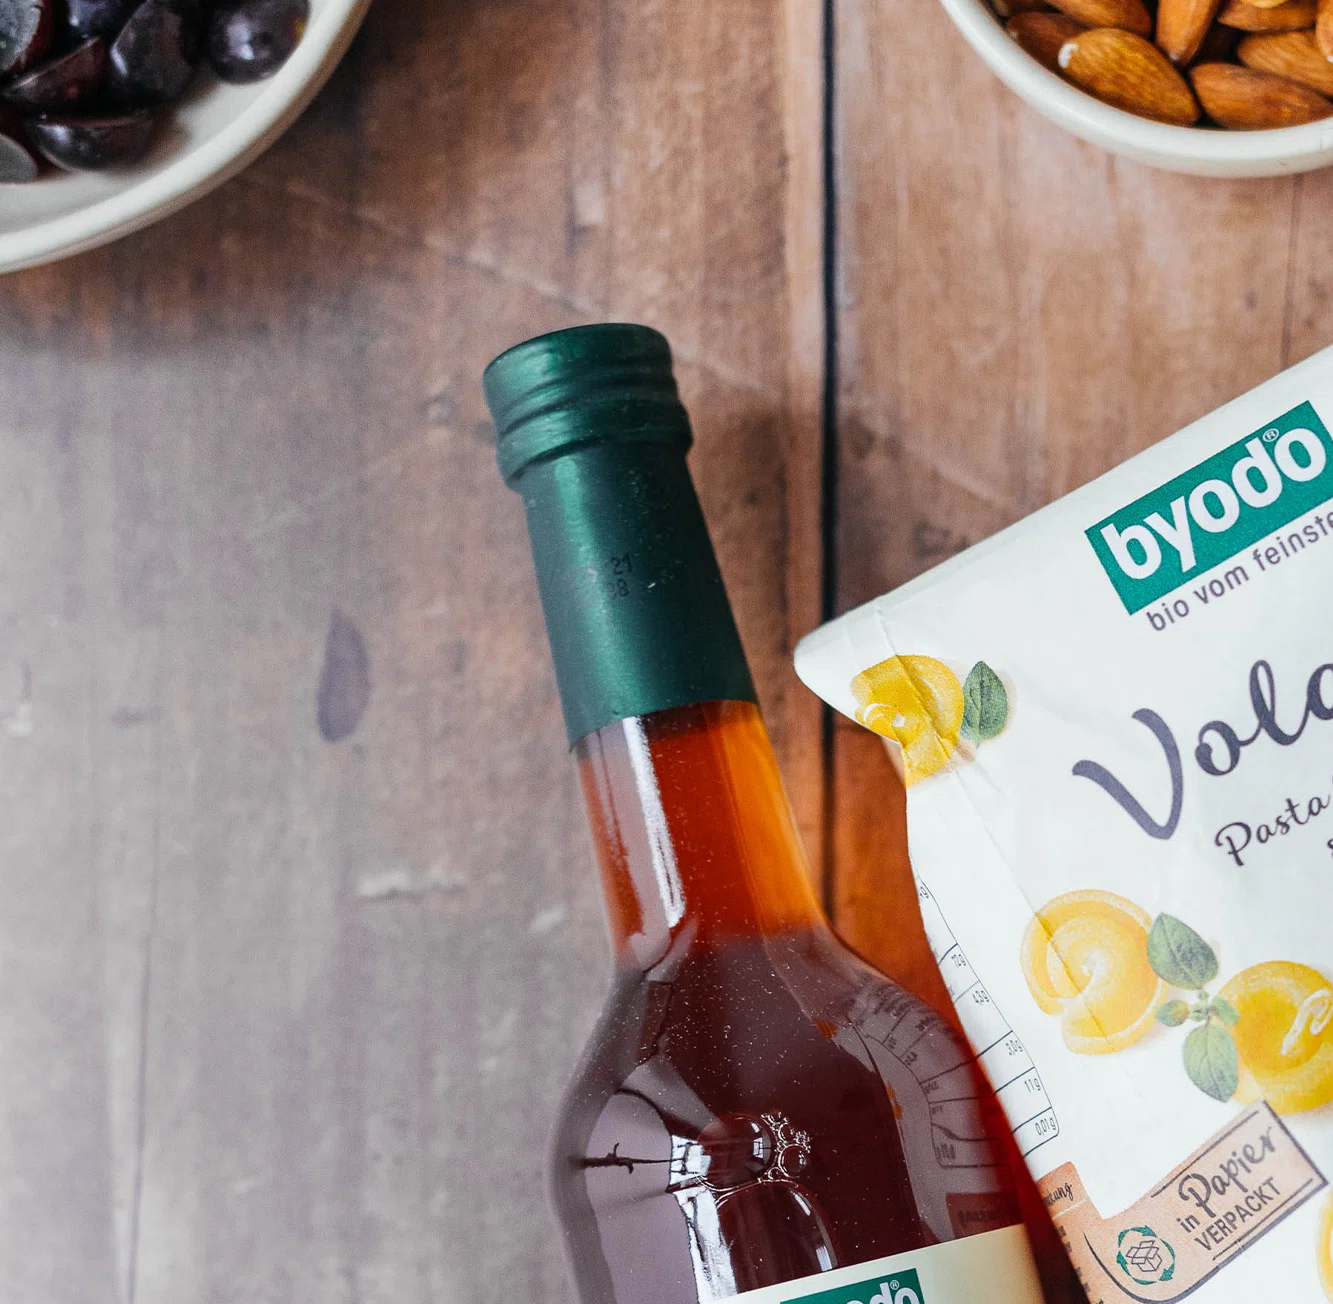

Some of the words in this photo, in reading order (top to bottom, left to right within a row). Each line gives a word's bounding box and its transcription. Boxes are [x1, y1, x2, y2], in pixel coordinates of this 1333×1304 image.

[1146, 599, 1190, 631] bio
[1193, 565, 1250, 604] vom
[1214, 794, 1331, 866] Pasta
[1179, 1126, 1278, 1220] Papier
[1177, 1211, 1200, 1234] in
[1194, 1177, 1281, 1252] VERPACKT
